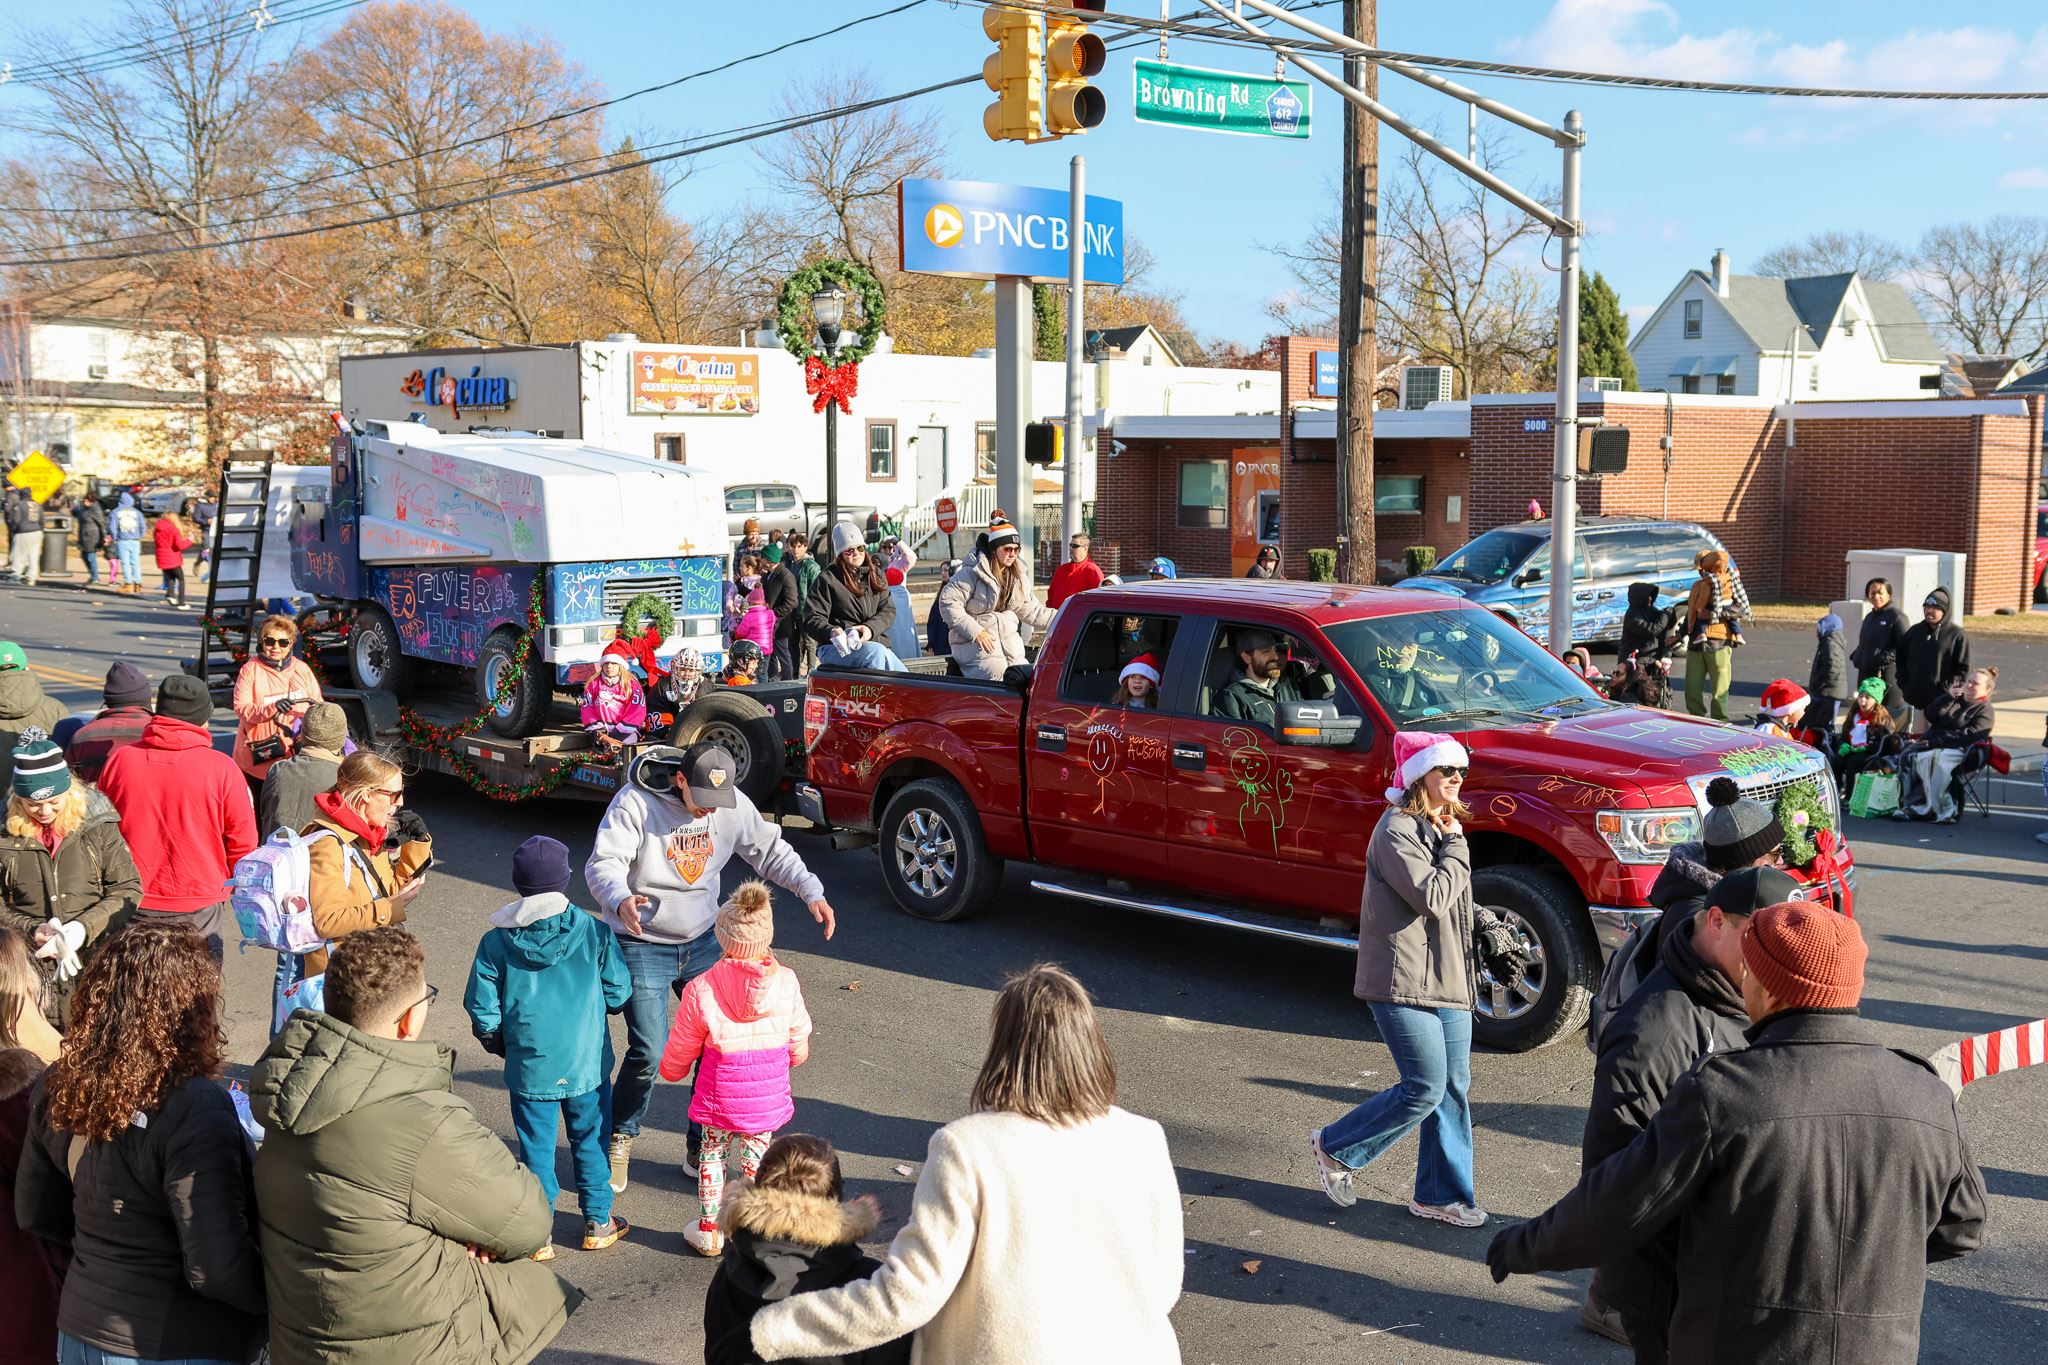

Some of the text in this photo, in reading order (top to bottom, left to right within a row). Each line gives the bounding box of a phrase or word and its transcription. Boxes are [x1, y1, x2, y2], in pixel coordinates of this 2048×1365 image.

[1141, 78, 1250, 122] Browning Rd
[1275, 108, 1292, 120] 612
[1273, 122, 1295, 131] COUNTY
[1048, 216, 1116, 258] BNK
[642, 382, 669, 392] ORDER
[1524, 419, 1547, 431] 5000
[938, 503, 953, 512] DO NOT
[941, 520, 954, 528] ENTER
[850, 685, 884, 699] MERRY
